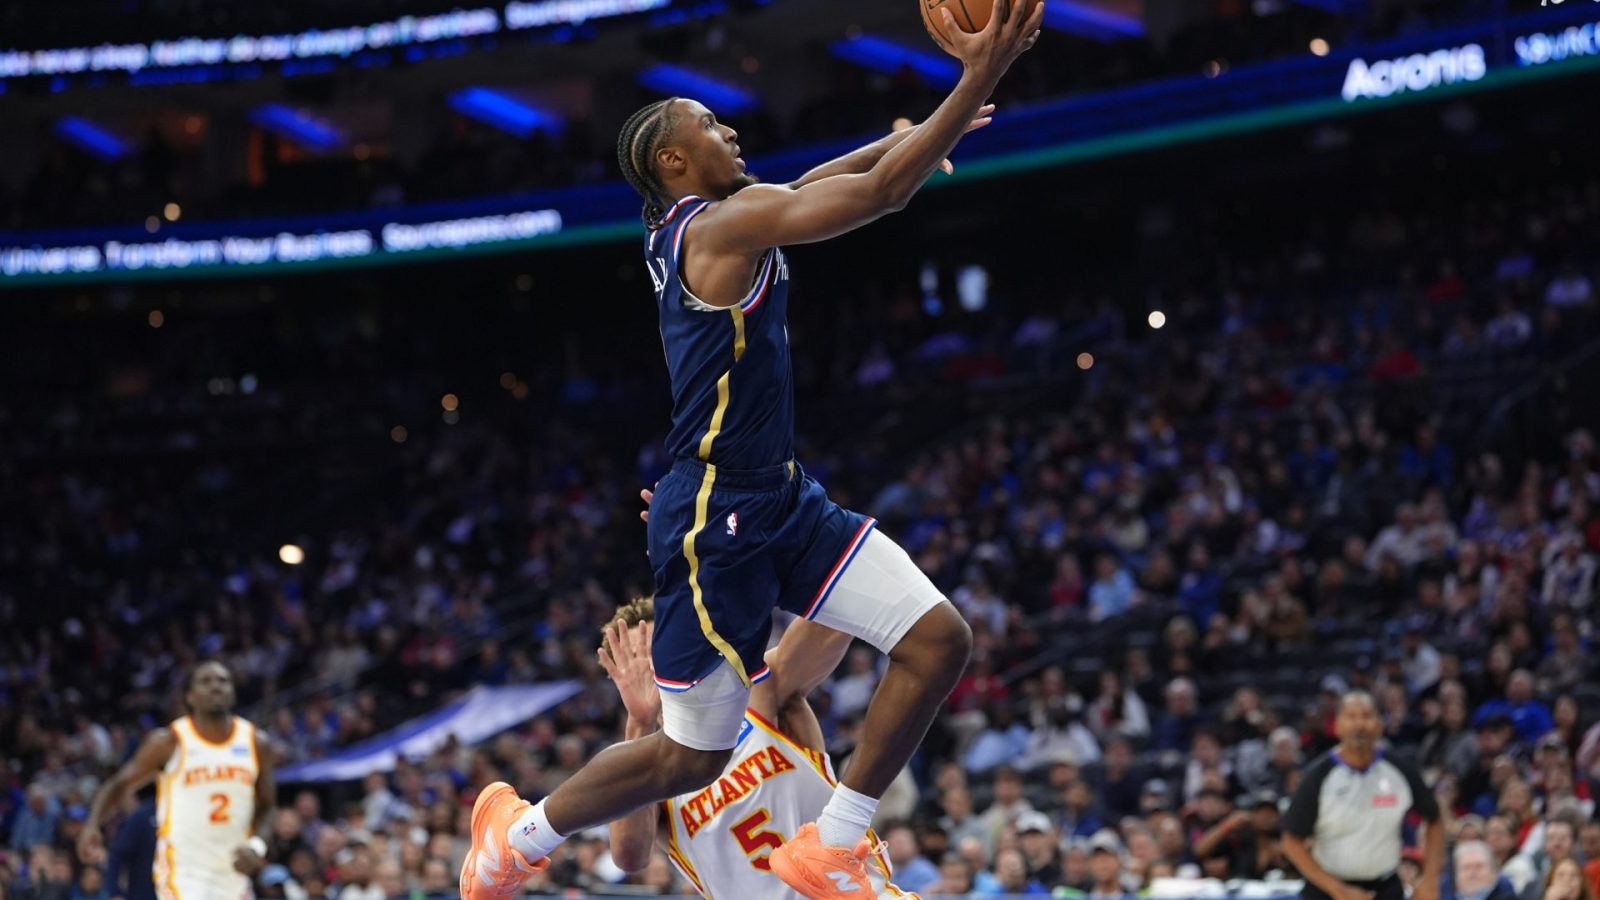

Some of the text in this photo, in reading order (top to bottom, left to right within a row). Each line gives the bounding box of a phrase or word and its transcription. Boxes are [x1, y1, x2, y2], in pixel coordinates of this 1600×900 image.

[1342, 43, 1486, 102] Acronis
[184, 766, 253, 786] ATLANTA
[680, 745, 796, 840] ATLANTA
[208, 793, 229, 822] 2
[729, 808, 787, 873] 5
